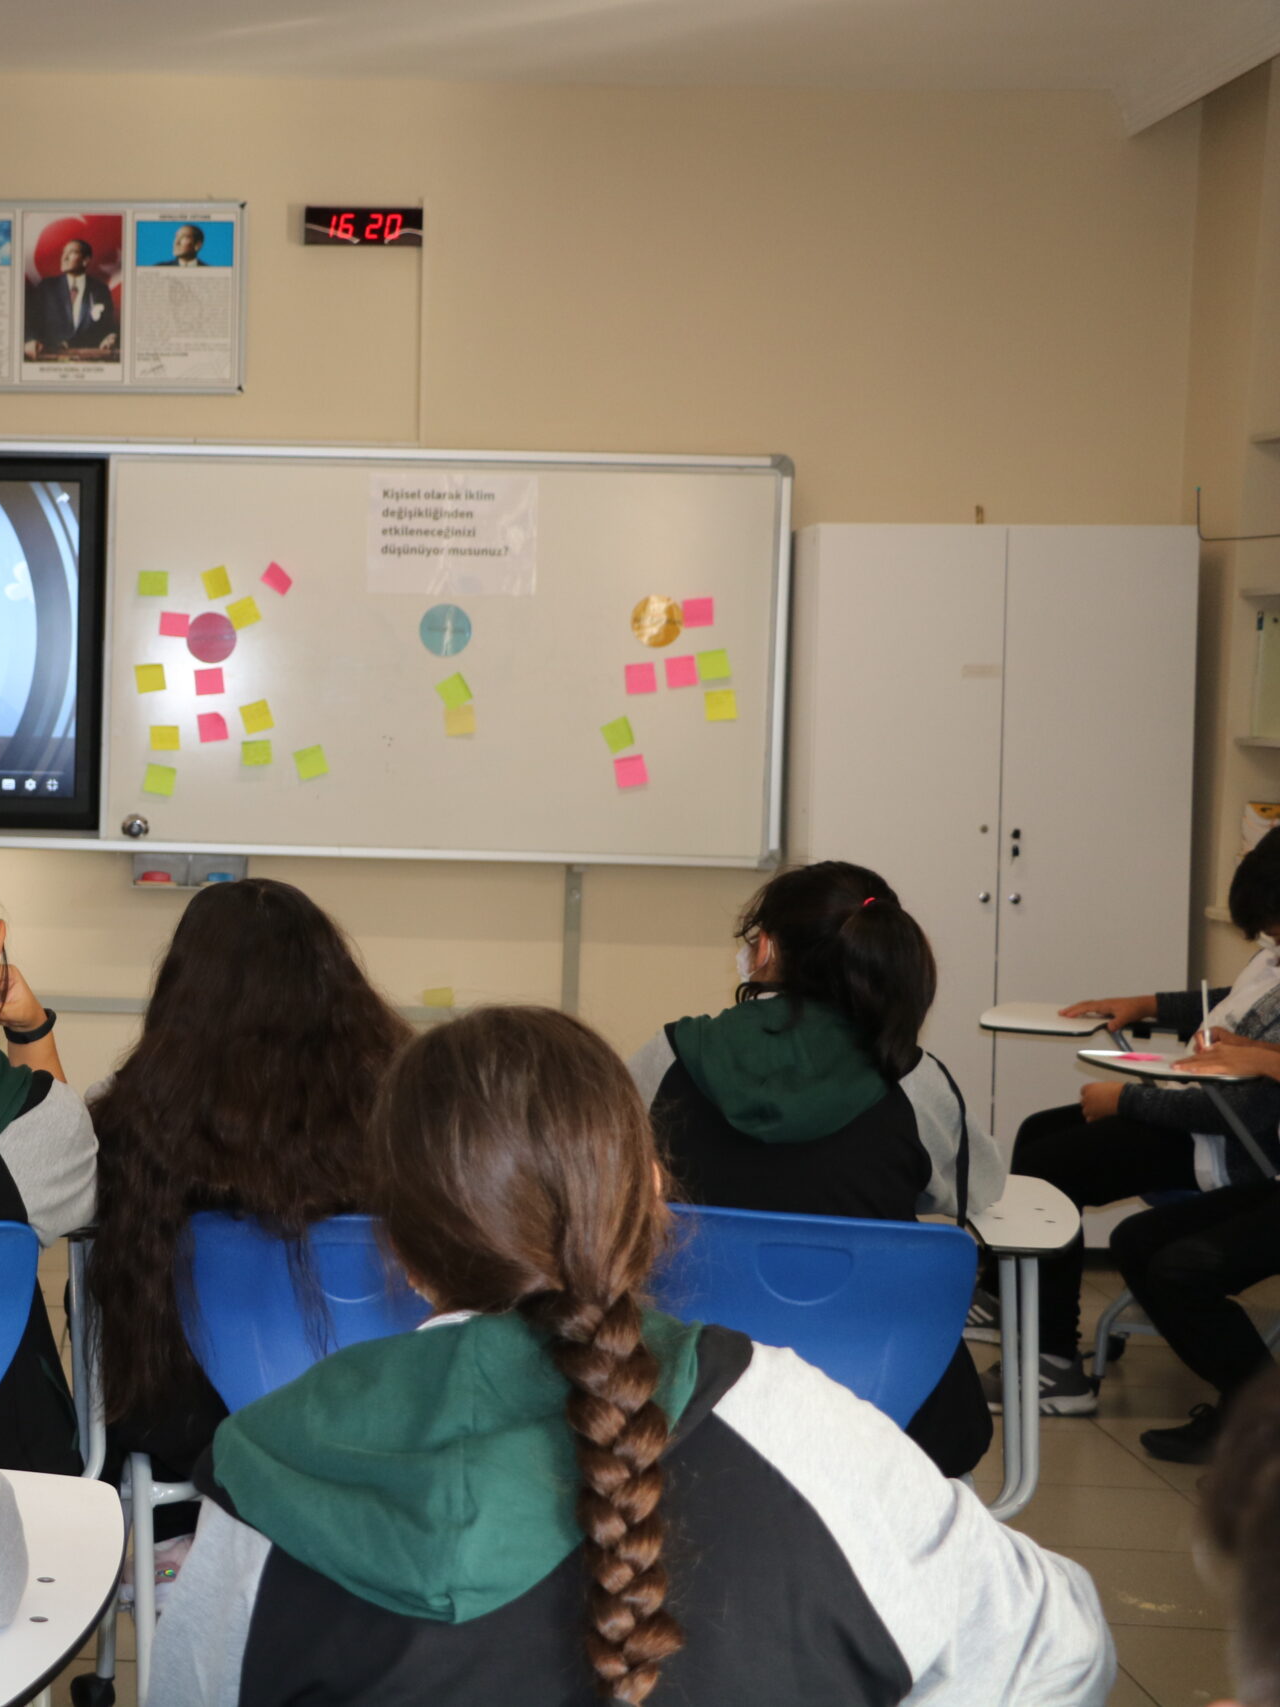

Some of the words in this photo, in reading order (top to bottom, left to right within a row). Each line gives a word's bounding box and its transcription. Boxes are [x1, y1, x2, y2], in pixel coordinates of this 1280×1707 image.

[329, 213, 355, 239] 16
[364, 213, 403, 240] 20
[382, 489, 420, 501] Kişisel
[424, 489, 461, 500] olarak
[465, 489, 495, 501] iklim
[382, 507, 473, 520] değişikliğinden
[381, 526, 476, 539] etkileneceğinizi
[381, 545, 444, 557] düşünüyor
[448, 546, 509, 557] musunuz?
